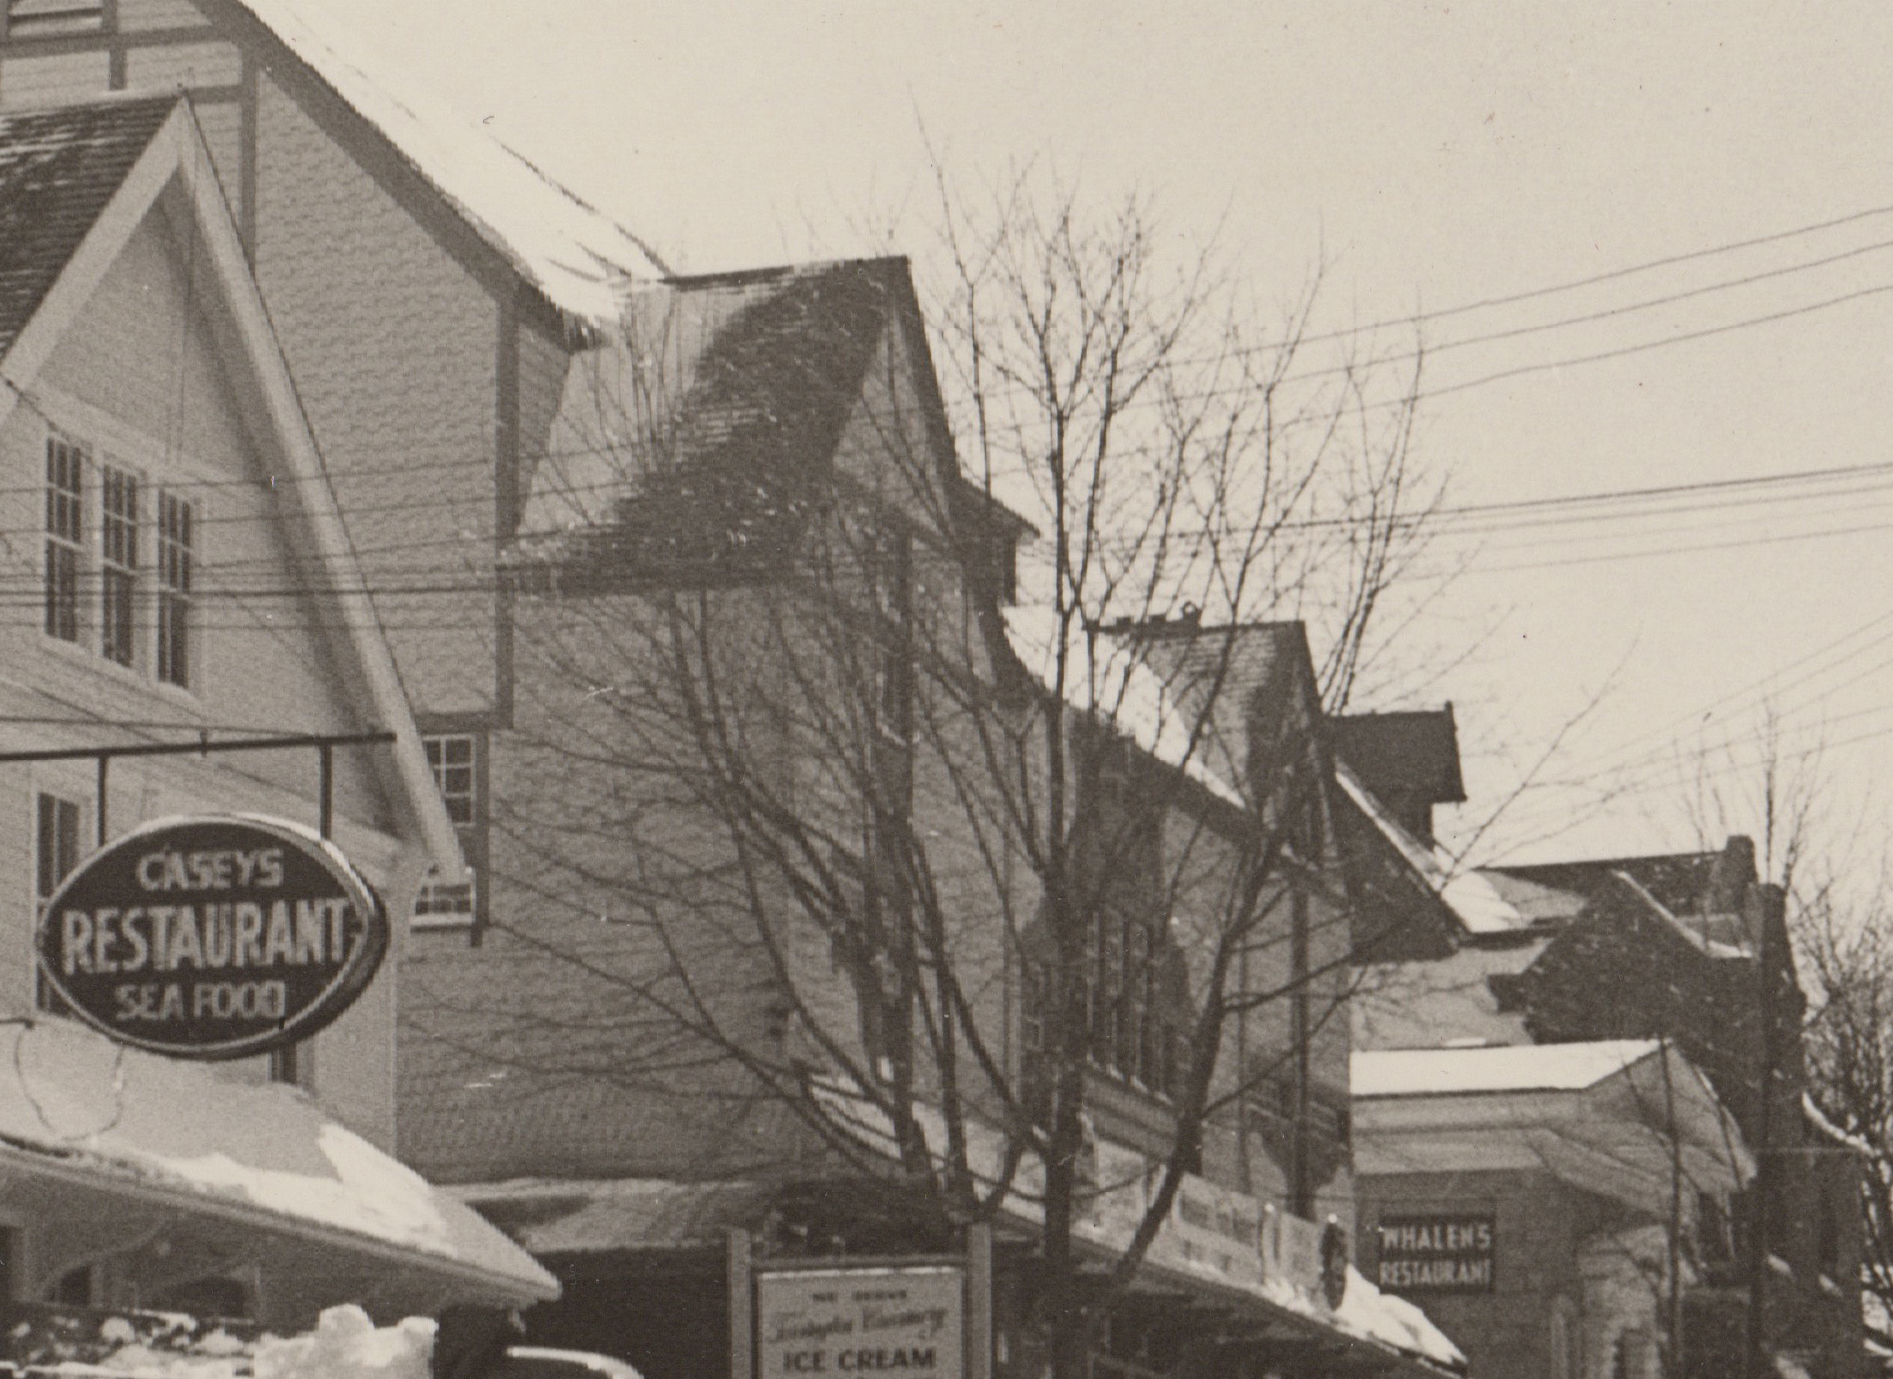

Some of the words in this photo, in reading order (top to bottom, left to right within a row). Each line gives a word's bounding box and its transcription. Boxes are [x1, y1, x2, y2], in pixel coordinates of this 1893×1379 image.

[61, 897, 350, 975] RESTAURANT
[114, 982, 185, 1022] SEA
[193, 978, 286, 1019] FOOD
[1383, 1223, 1491, 1251] WHALENS
[1379, 1258, 1492, 1286] RESTAURANT
[782, 1351, 828, 1372] ICE
[838, 1347, 937, 1371] CREAM
